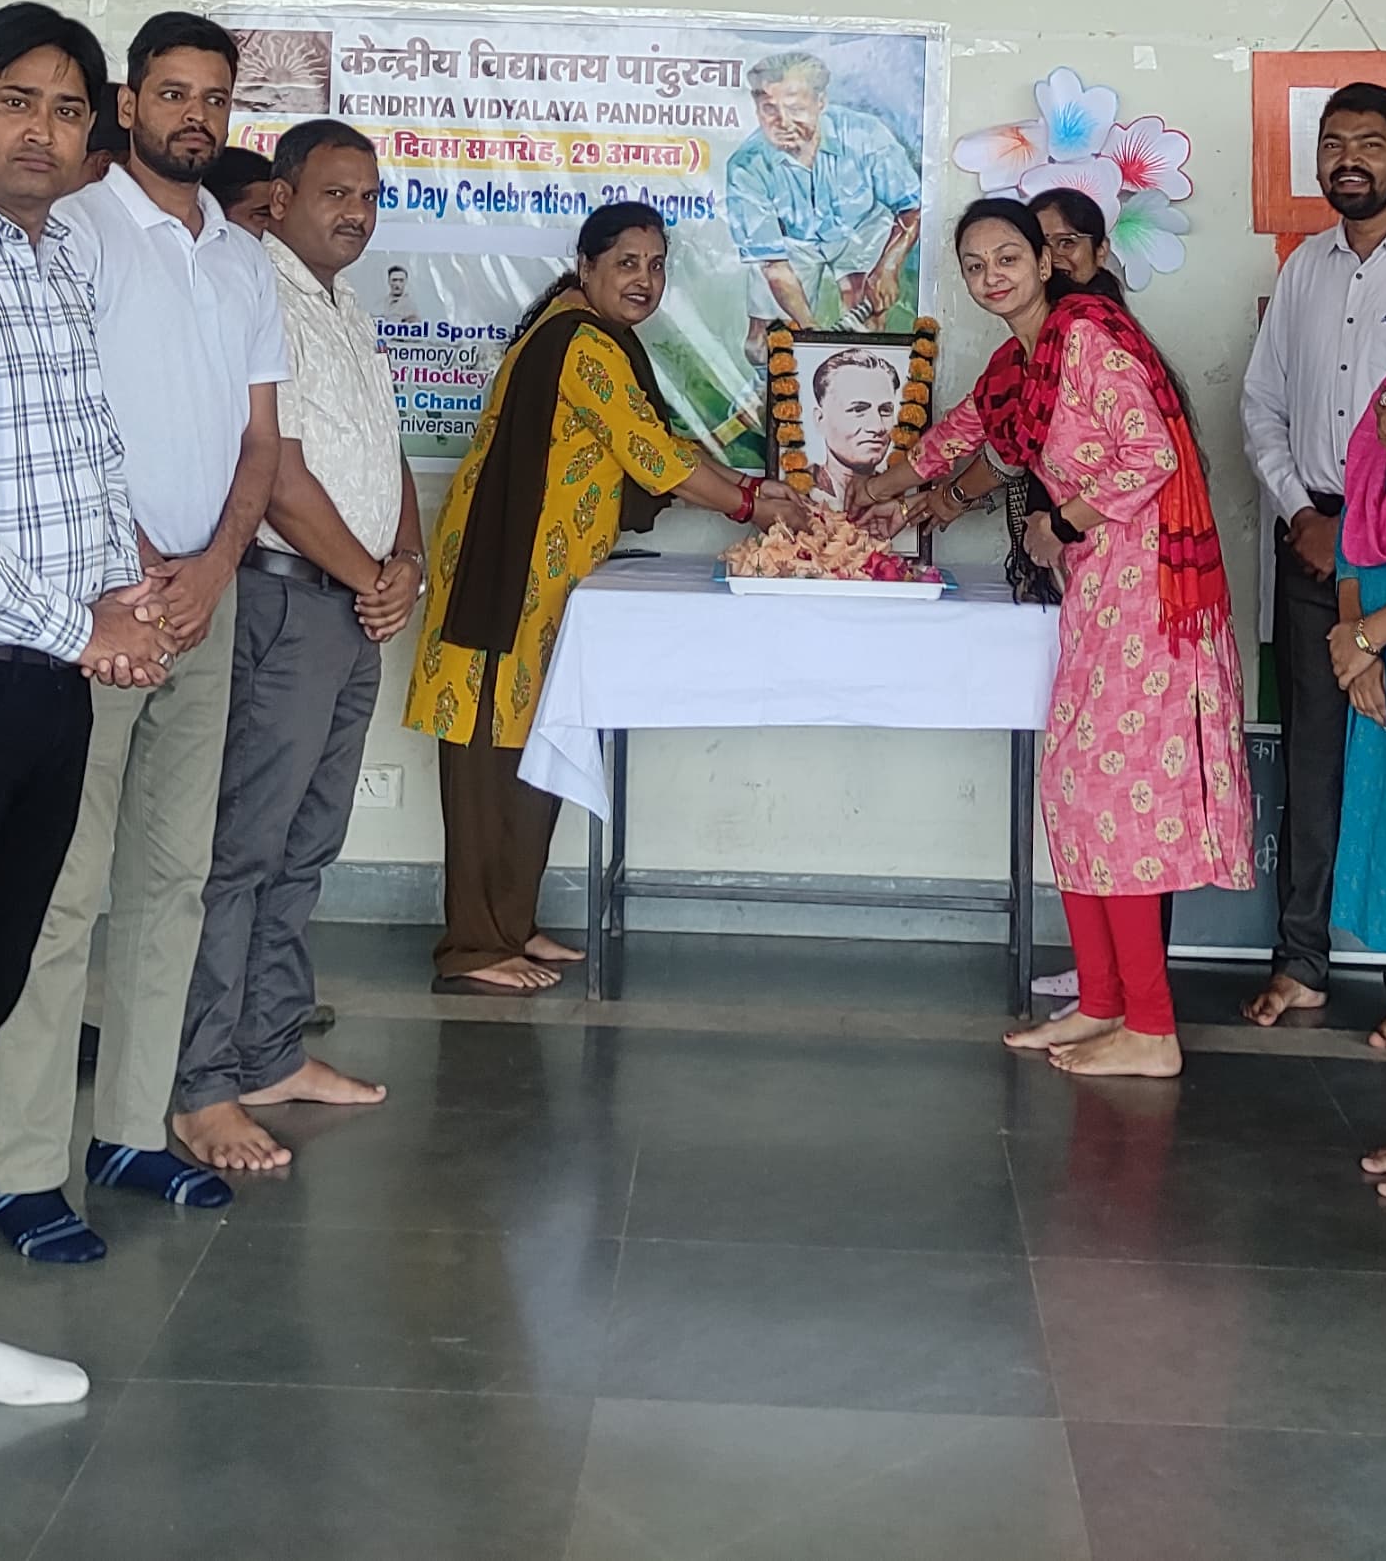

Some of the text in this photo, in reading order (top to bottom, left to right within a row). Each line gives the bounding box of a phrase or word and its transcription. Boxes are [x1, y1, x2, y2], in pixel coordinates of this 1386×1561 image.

[339, 34, 461, 81] केन्द्रीय
[467, 38, 609, 83] विद्यालय
[339, 94, 740, 129] KENDRIYA VIDYALAYA PANDHURNA
[394, 131, 461, 159] दिवस
[572, 142, 600, 164] 29
[606, 144, 683, 166] अगस्त
[407, 178, 448, 219] Day
[375, 319, 429, 338] ional
[436, 322, 507, 342] Sports
[459, 345, 478, 363] of
[392, 366, 408, 382] of
[414, 392, 482, 411] Chand
